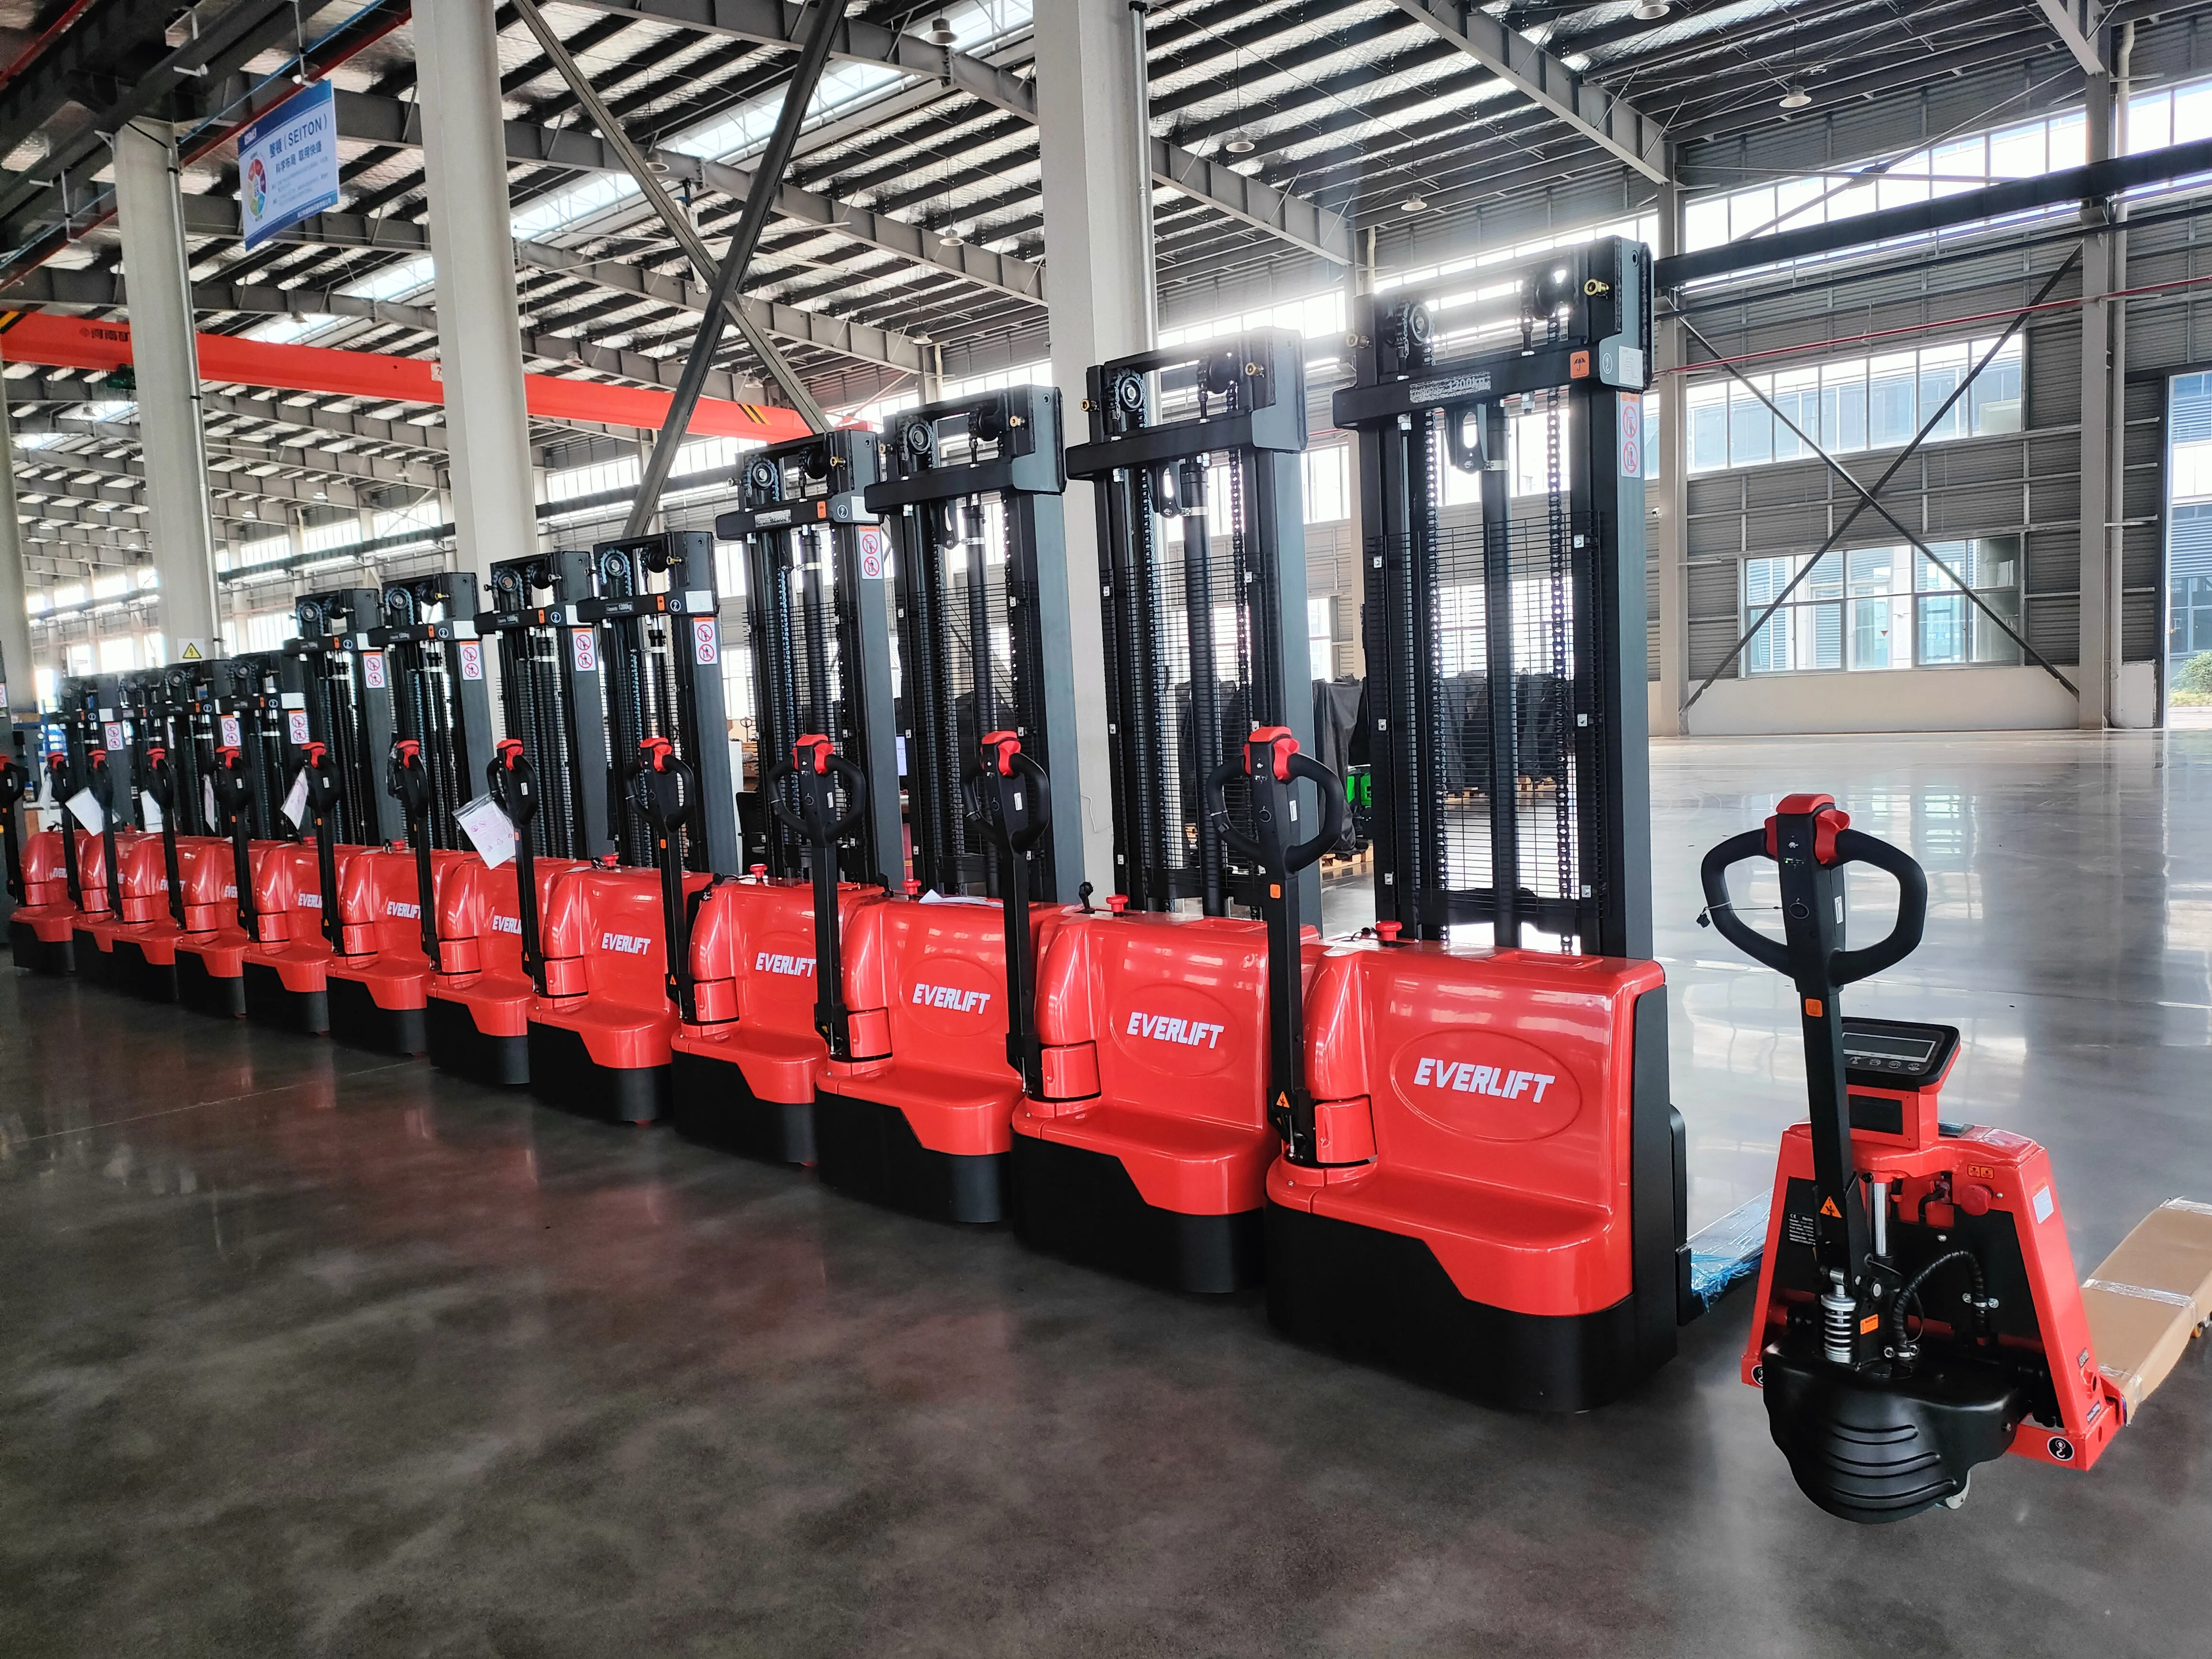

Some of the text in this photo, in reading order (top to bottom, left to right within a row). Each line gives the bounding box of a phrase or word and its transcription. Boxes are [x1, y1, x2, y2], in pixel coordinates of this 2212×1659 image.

[298, 893, 322, 908] EVERLI
[601, 932, 651, 956] EVERLIFT
[755, 952, 817, 978] EVERLIFT
[912, 983, 991, 1015] EVERLIFT
[1127, 1012, 1224, 1049] EVERLIFT
[1413, 1058, 1555, 1103] EVERLIFT
